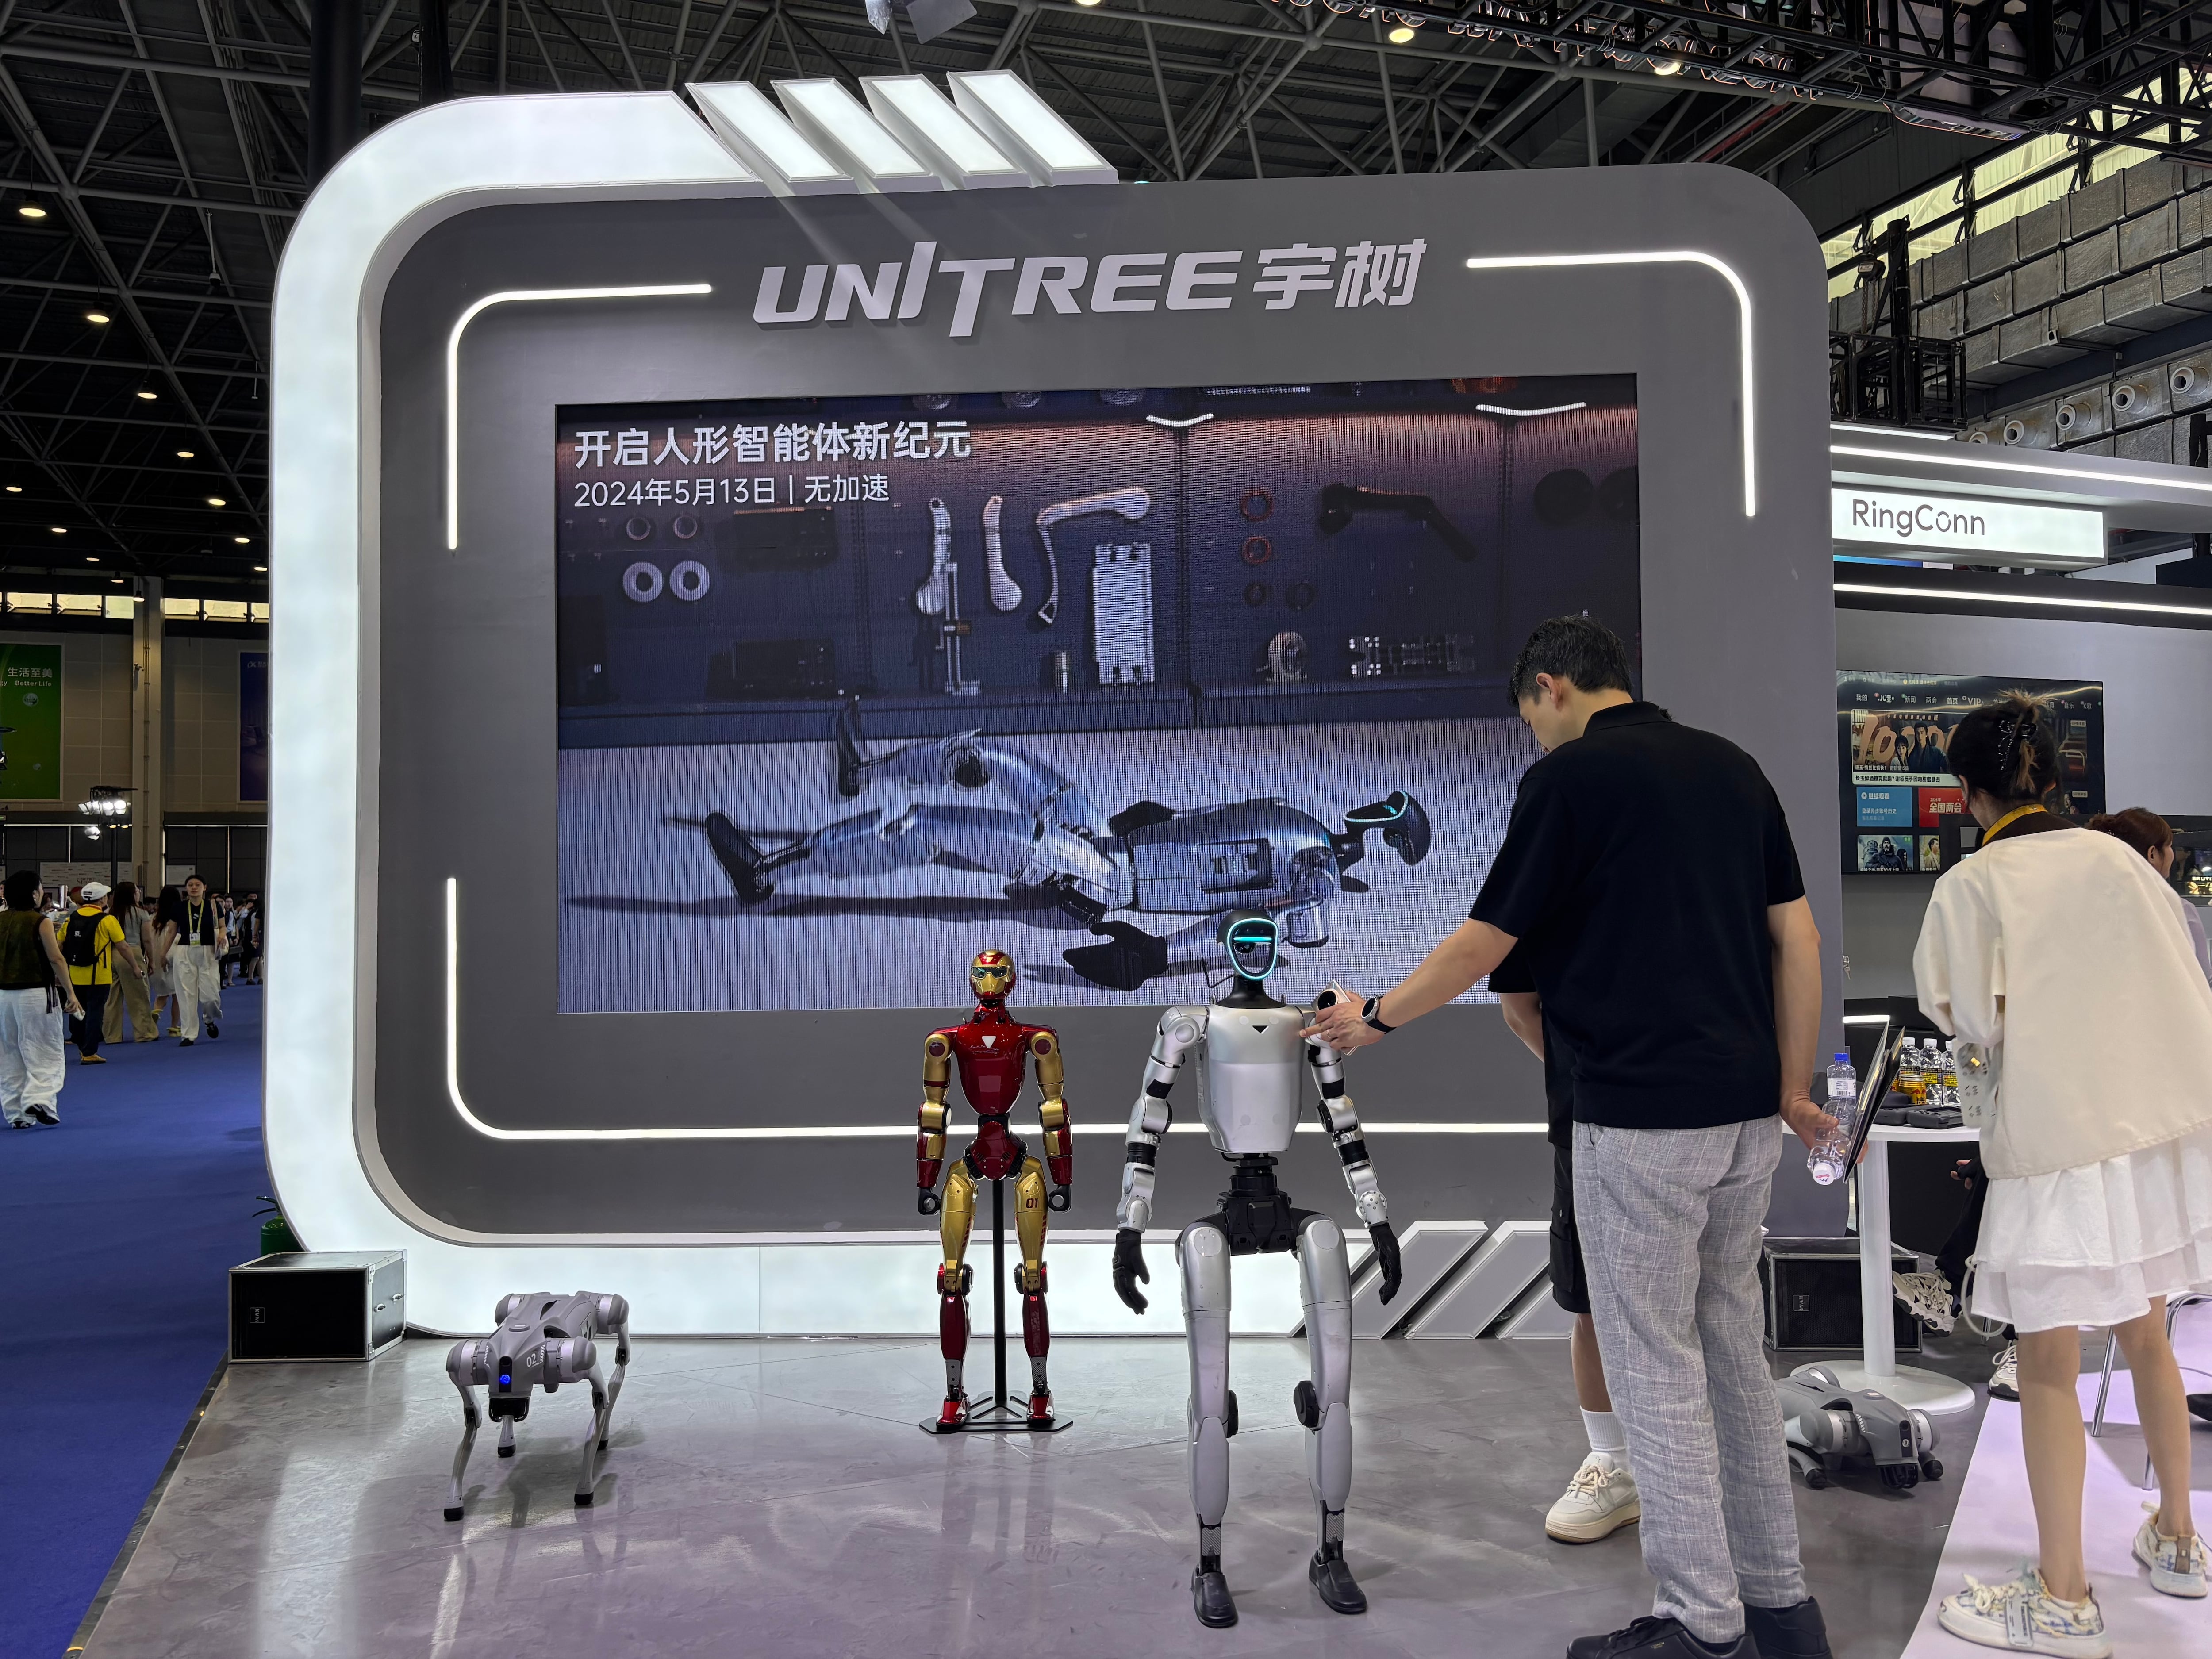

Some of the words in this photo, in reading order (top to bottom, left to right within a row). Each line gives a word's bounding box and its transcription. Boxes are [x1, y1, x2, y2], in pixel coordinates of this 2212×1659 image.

[753, 242, 1243, 337] UNITREE
[1253, 238, 1427, 311] 宇树
[574, 420, 972, 469] 开启人形智能体新纪元
[1852, 499, 1985, 537] RingConn
[8, 667, 53, 678] 生活至美
[1929, 803, 1962, 813] 全国两会
[1026, 1198, 1038, 1208] 01
[526, 1353, 537, 1367] 02
